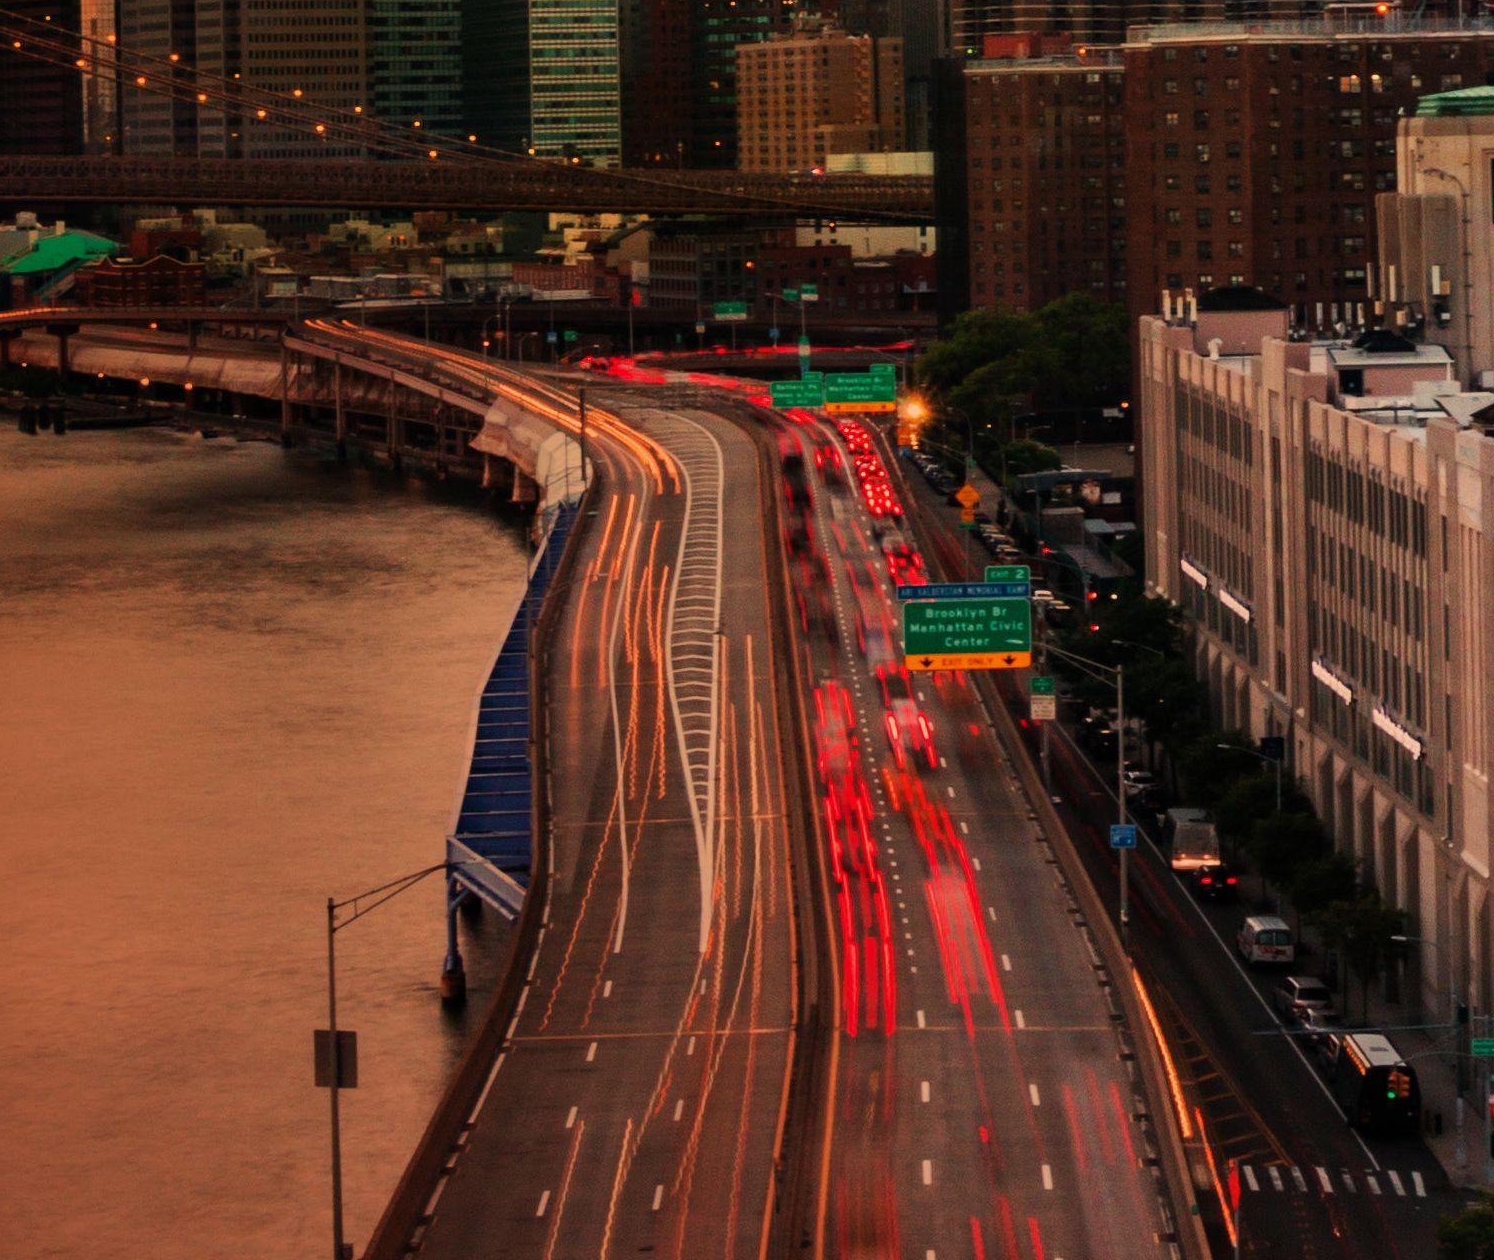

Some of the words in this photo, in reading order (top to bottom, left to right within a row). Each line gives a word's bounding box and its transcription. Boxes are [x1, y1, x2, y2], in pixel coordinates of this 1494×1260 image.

[1015, 569, 1025, 579] 2
[925, 608, 986, 619] Brooklyn
[992, 606, 1007, 617] Br
[910, 622, 984, 633] Manhattan
[990, 621, 1024, 631] Civic
[945, 637, 990, 647] Center
